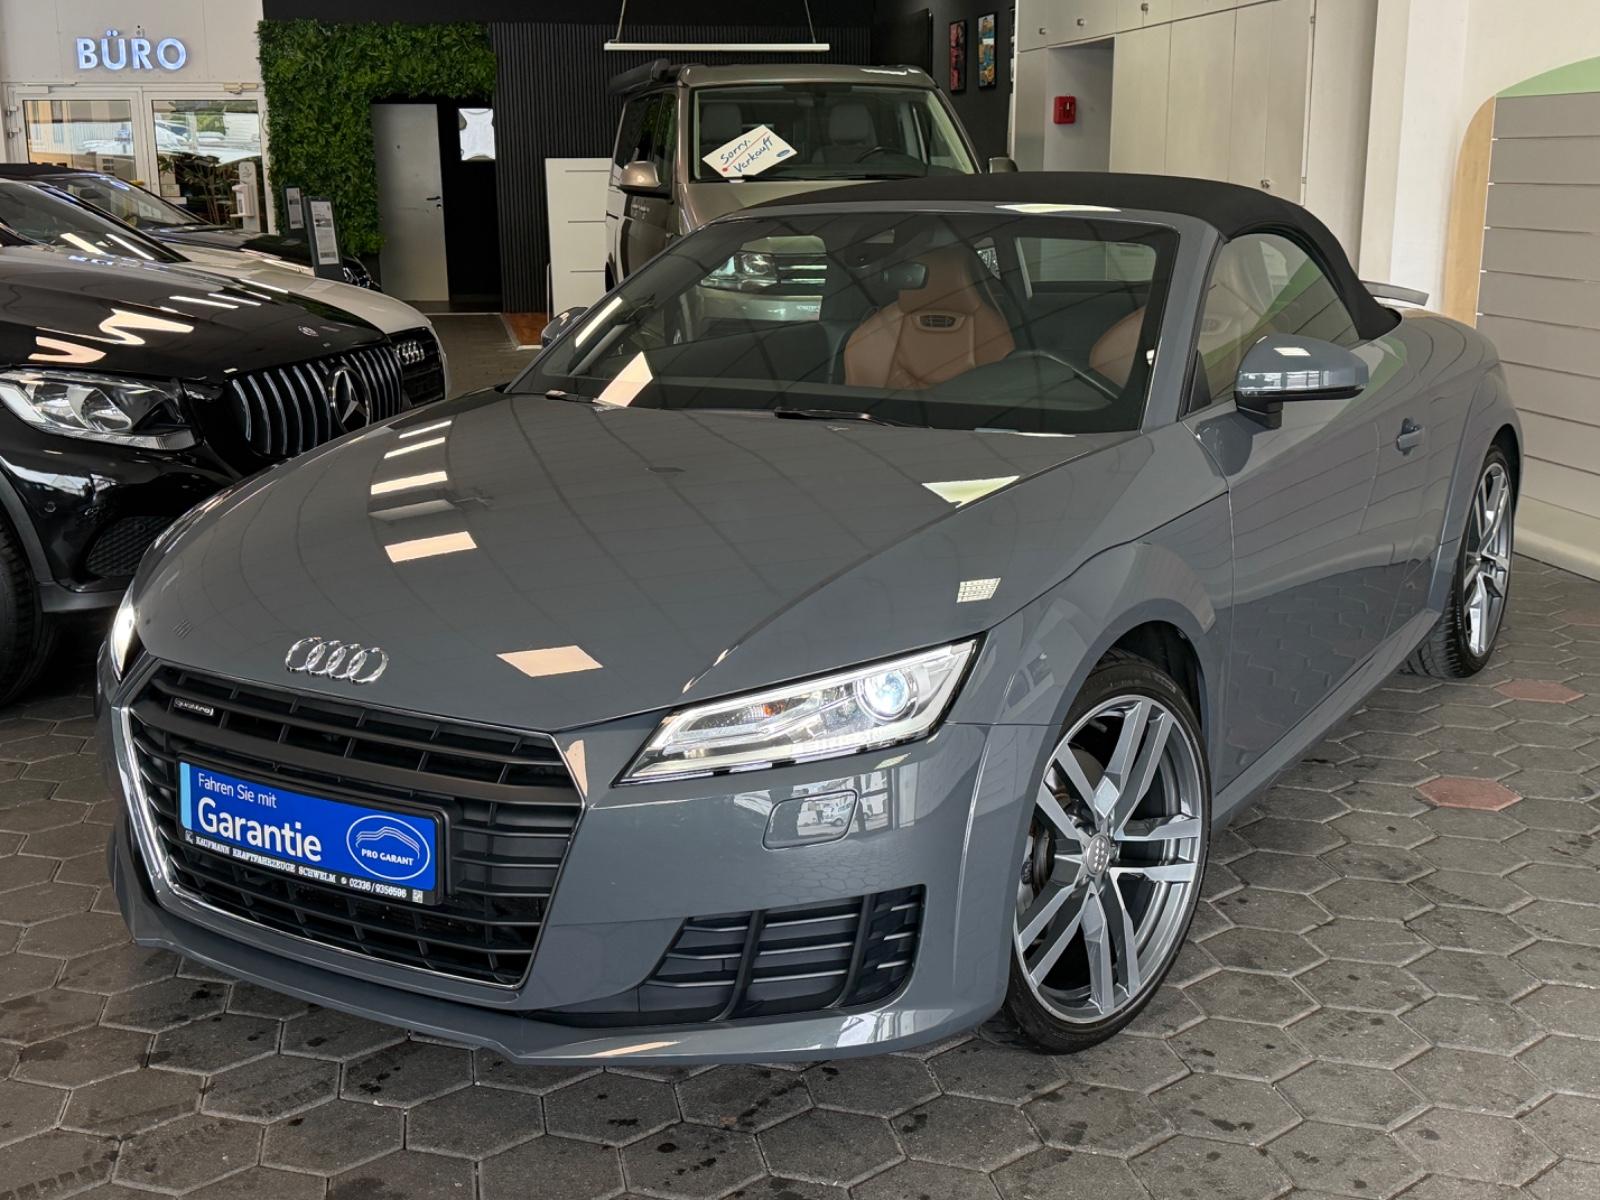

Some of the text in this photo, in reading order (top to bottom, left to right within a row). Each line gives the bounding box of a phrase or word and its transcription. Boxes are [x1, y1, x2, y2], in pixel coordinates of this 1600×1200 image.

[76, 29, 187, 70] BÜRO
[198, 772, 278, 809] Fahren Sie mit
[197, 796, 322, 862] Garantie
[195, 836, 230, 855] KAUFMANN
[232, 847, 296, 874] KRAFTFAHRZEUGE
[298, 865, 336, 884] SCHWELM
[361, 848, 415, 866] PRO GARANT
